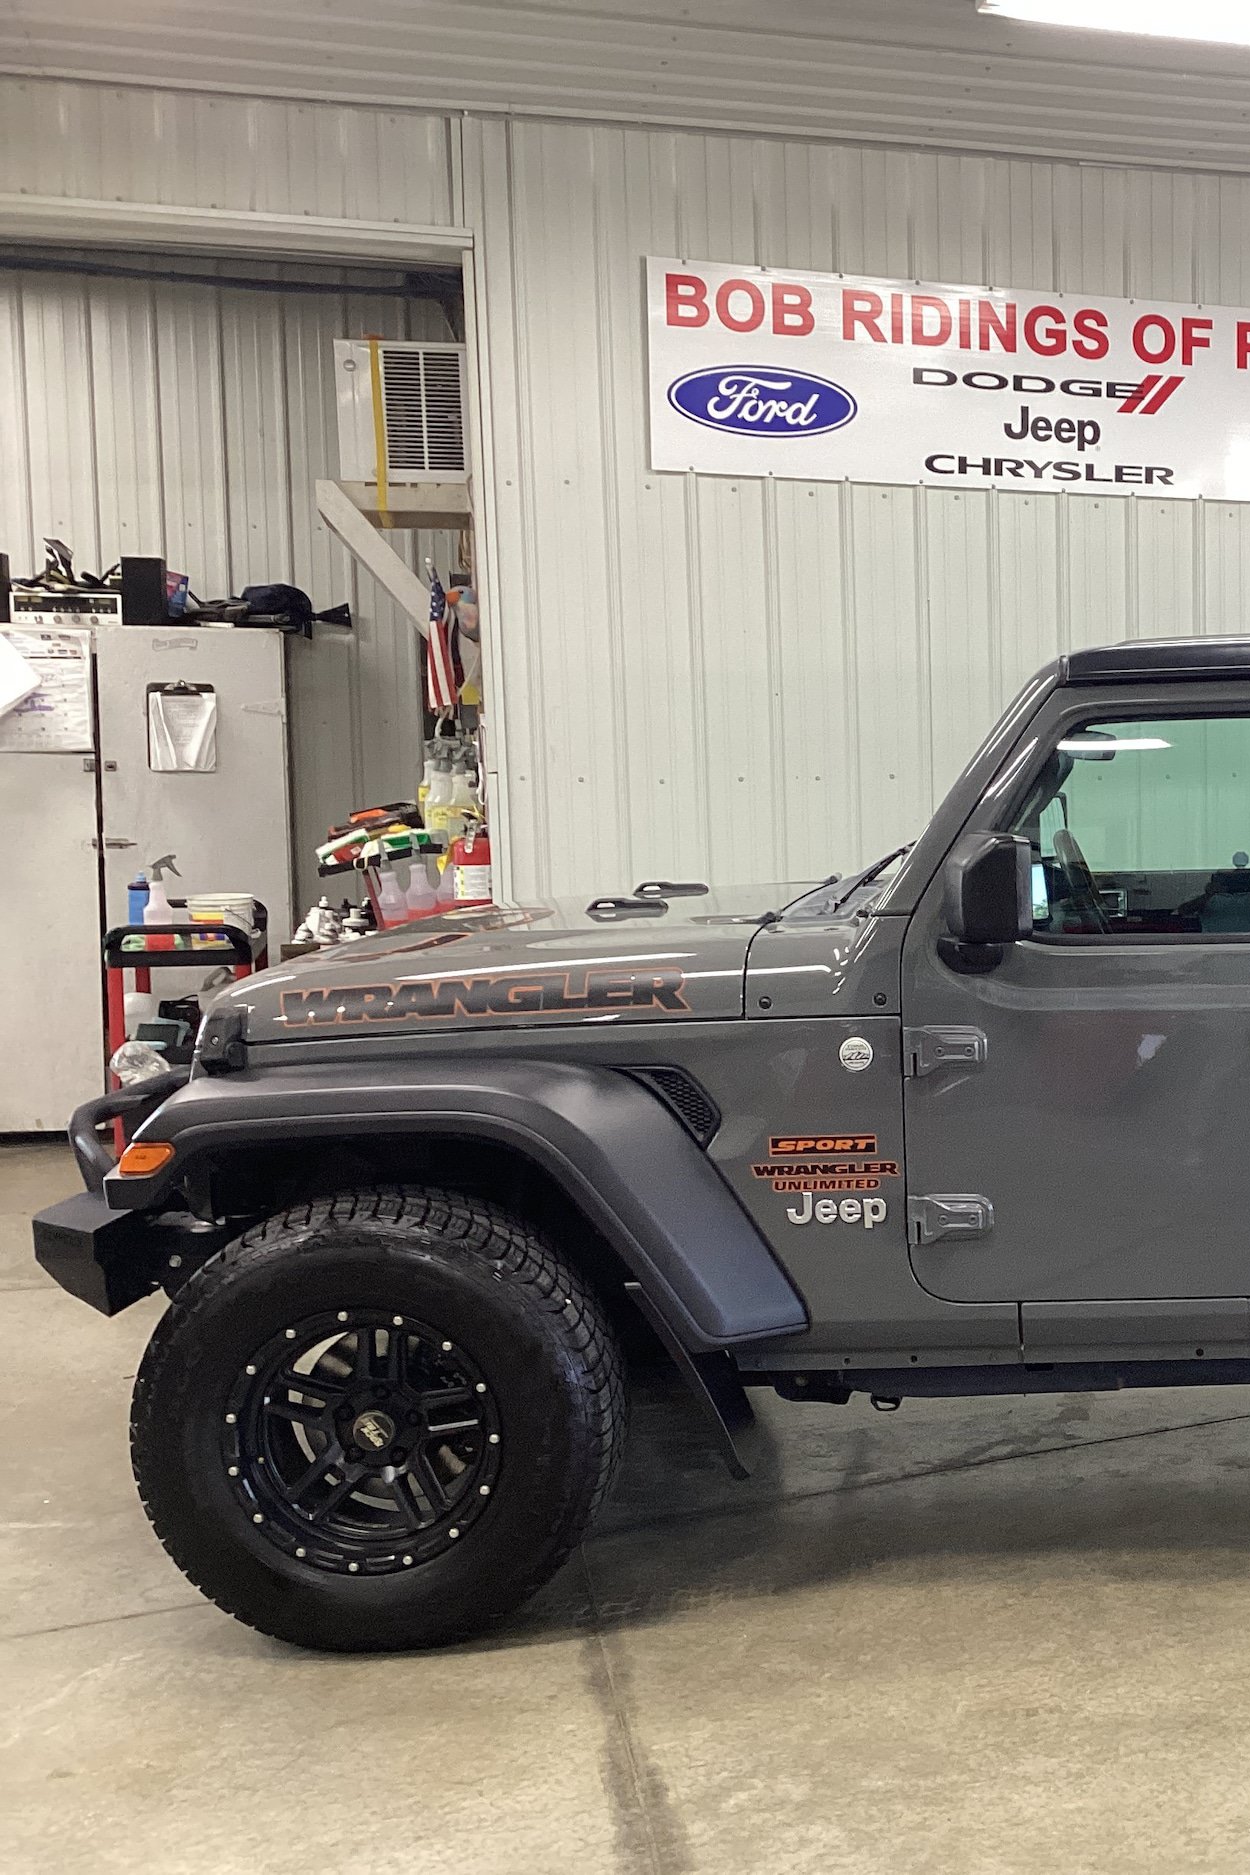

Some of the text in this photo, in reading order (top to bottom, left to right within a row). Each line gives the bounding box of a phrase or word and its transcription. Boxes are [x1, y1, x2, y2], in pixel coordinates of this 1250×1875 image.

[665, 272, 816, 337] BOB
[842, 288, 1110, 361] RIDINGS
[1131, 313, 1214, 367] OF
[706, 374, 821, 427] Ford
[912, 366, 1146, 401] DODGE
[1003, 405, 1102, 452] Jeep
[924, 453, 1175, 486] CHRYSLER
[280, 966, 692, 1028] WRANGLER
[776, 1138, 876, 1152] SPORT
[752, 1162, 899, 1177] WRANGLER
[773, 1178, 880, 1191] UNLIMITED
[786, 1191, 888, 1229] Jeep
